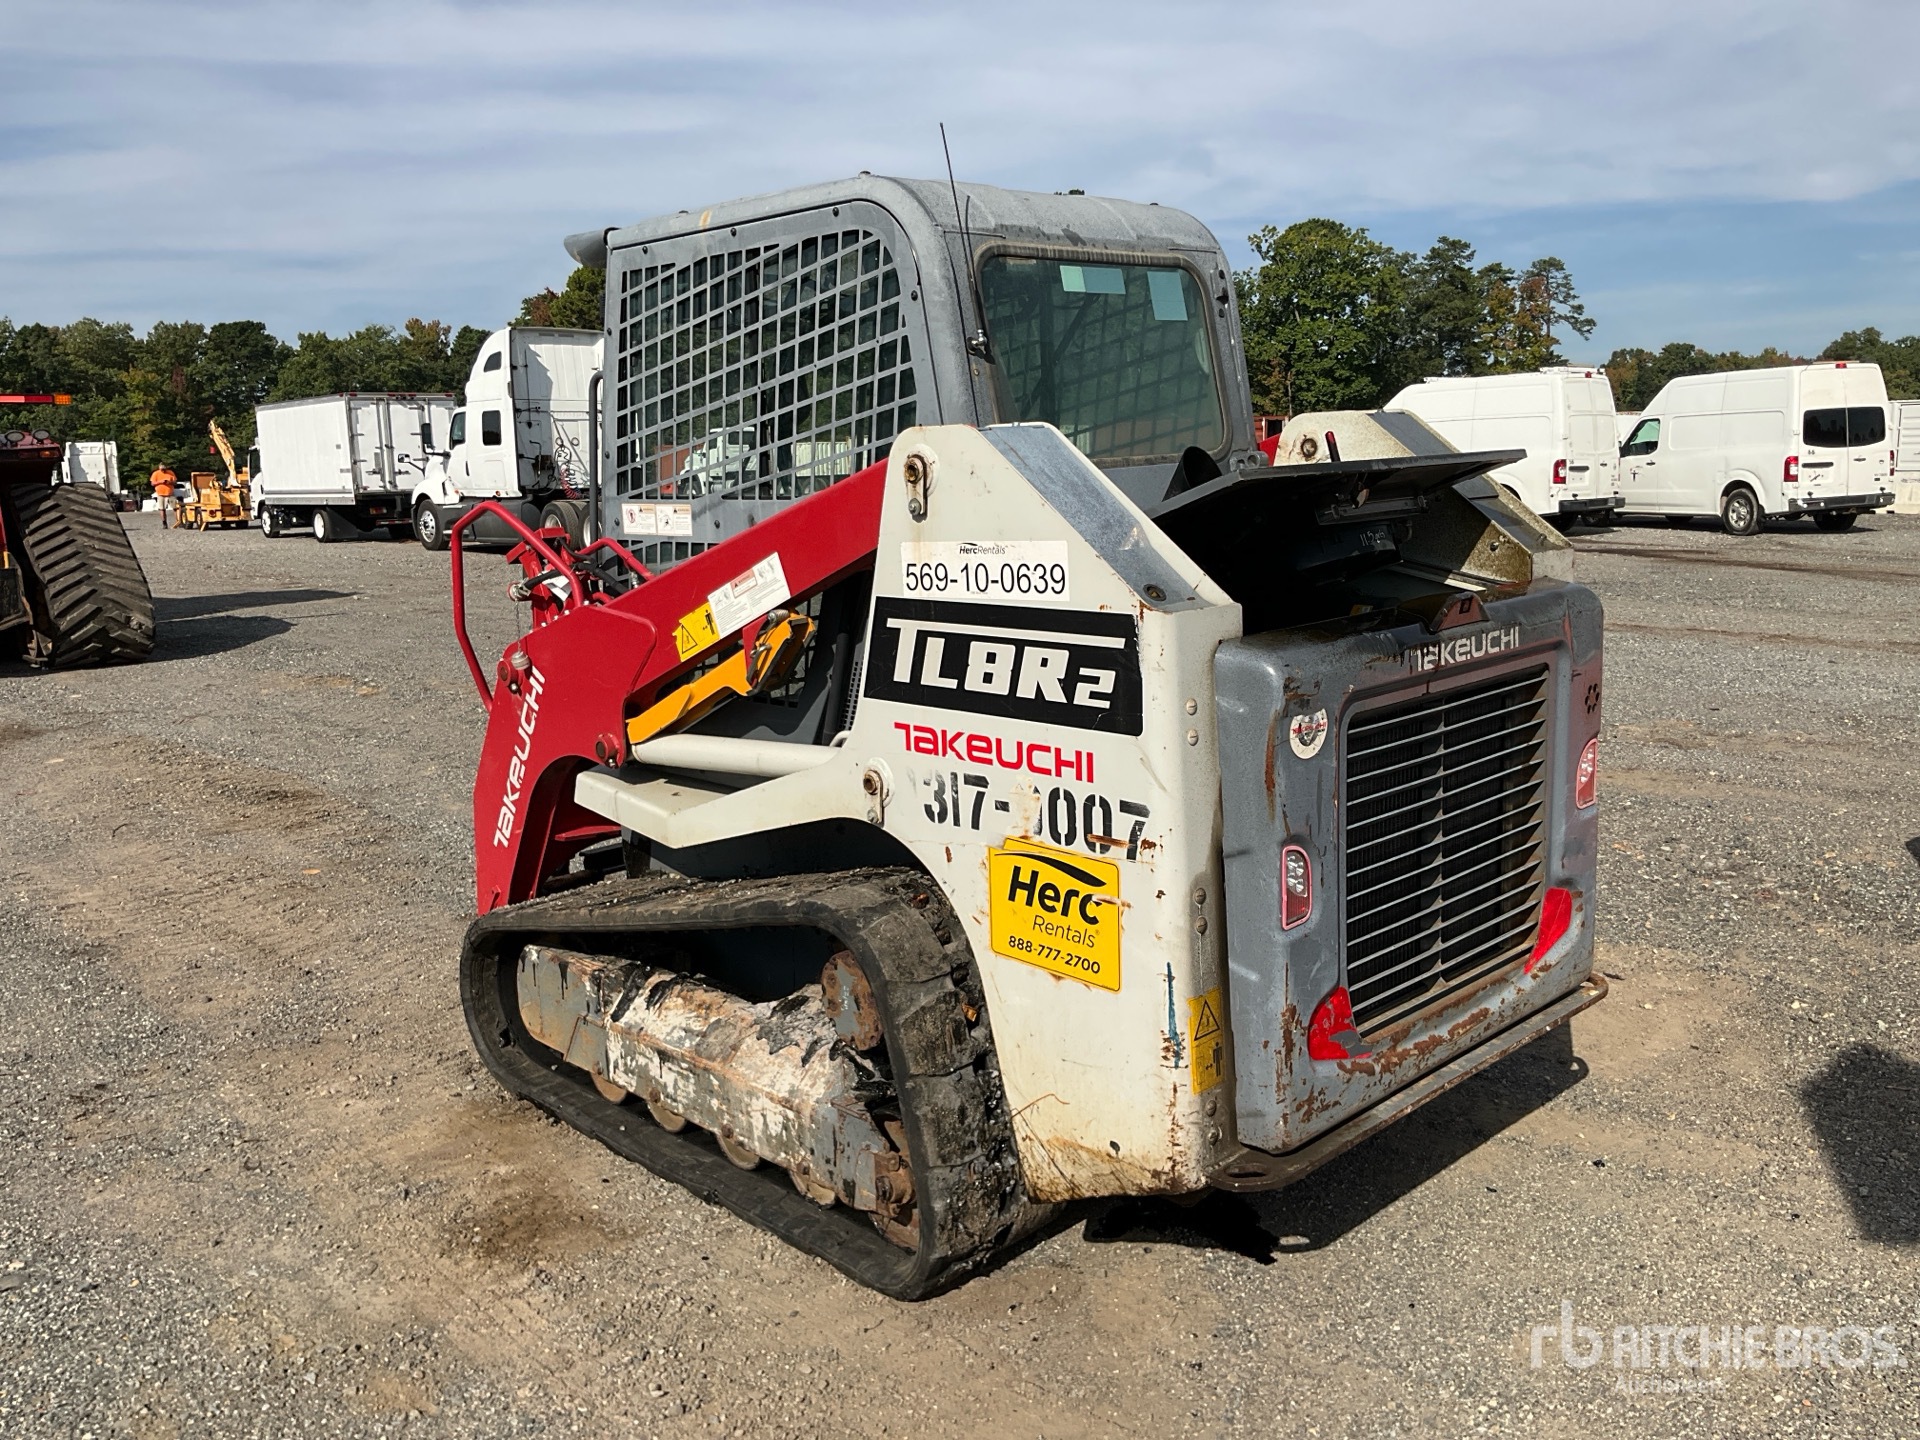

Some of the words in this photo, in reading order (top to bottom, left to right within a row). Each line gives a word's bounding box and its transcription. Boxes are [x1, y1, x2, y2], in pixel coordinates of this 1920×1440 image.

[905, 562, 1066, 595] 569-10-0639
[886, 617, 1126, 710] TL8R2
[493, 665, 546, 849] TAKEUCHI
[894, 722, 1094, 784] TAKEUCHI
[923, 769, 1151, 862] 317-007
[1008, 864, 1103, 926] Herc
[1008, 935, 1101, 975] 888-777-2700
[1032, 914, 1096, 949] Rentals
